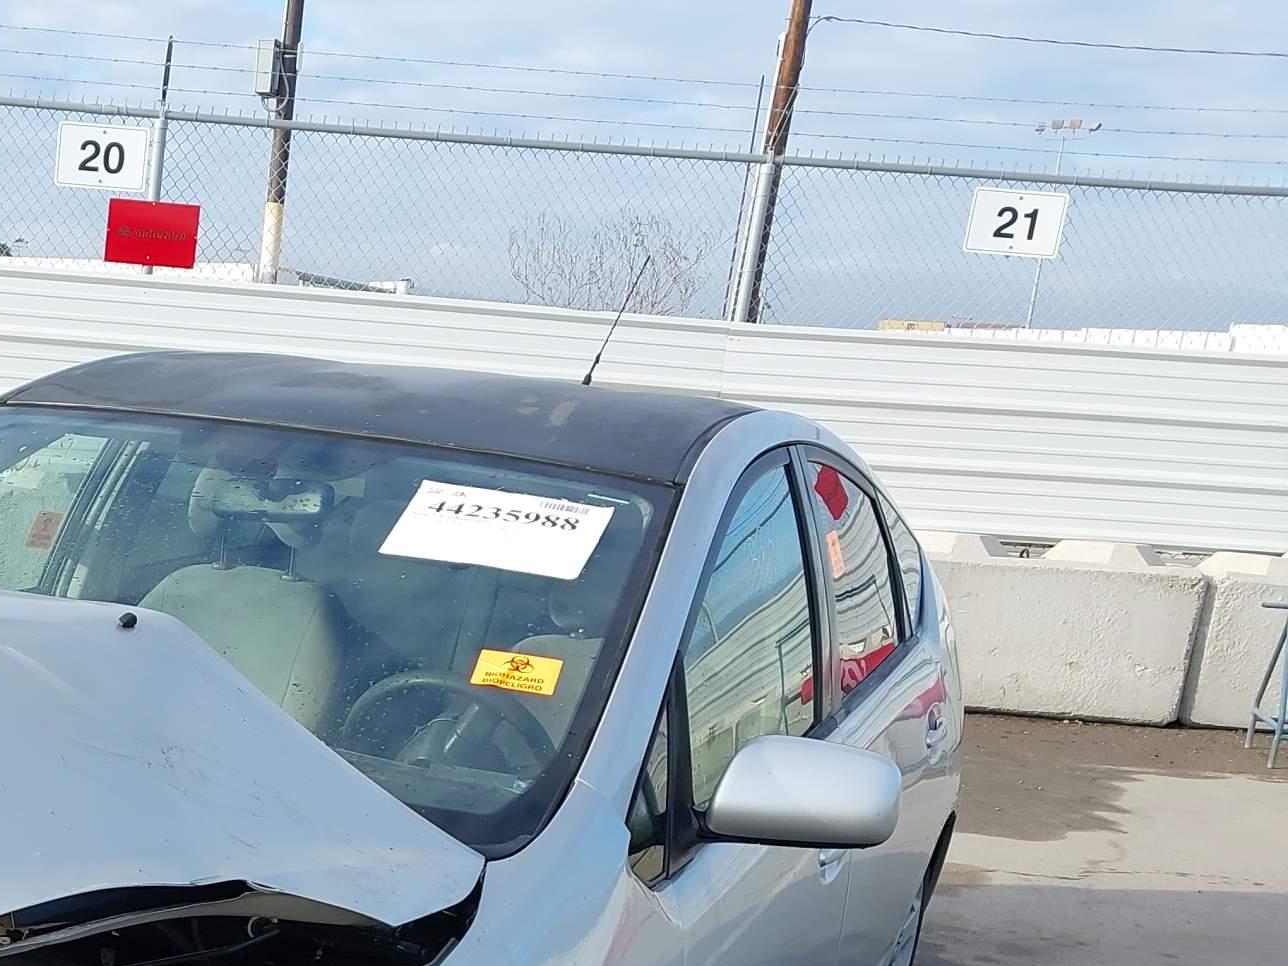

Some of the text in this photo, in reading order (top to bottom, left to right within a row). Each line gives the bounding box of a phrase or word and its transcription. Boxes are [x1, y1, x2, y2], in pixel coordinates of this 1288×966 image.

[78, 140, 125, 174] 20
[992, 206, 1039, 241] 21
[427, 500, 581, 531] 44235988
[481, 678, 543, 691] BIOPELIGRO
[484, 671, 545, 684] BIOHAZARD
